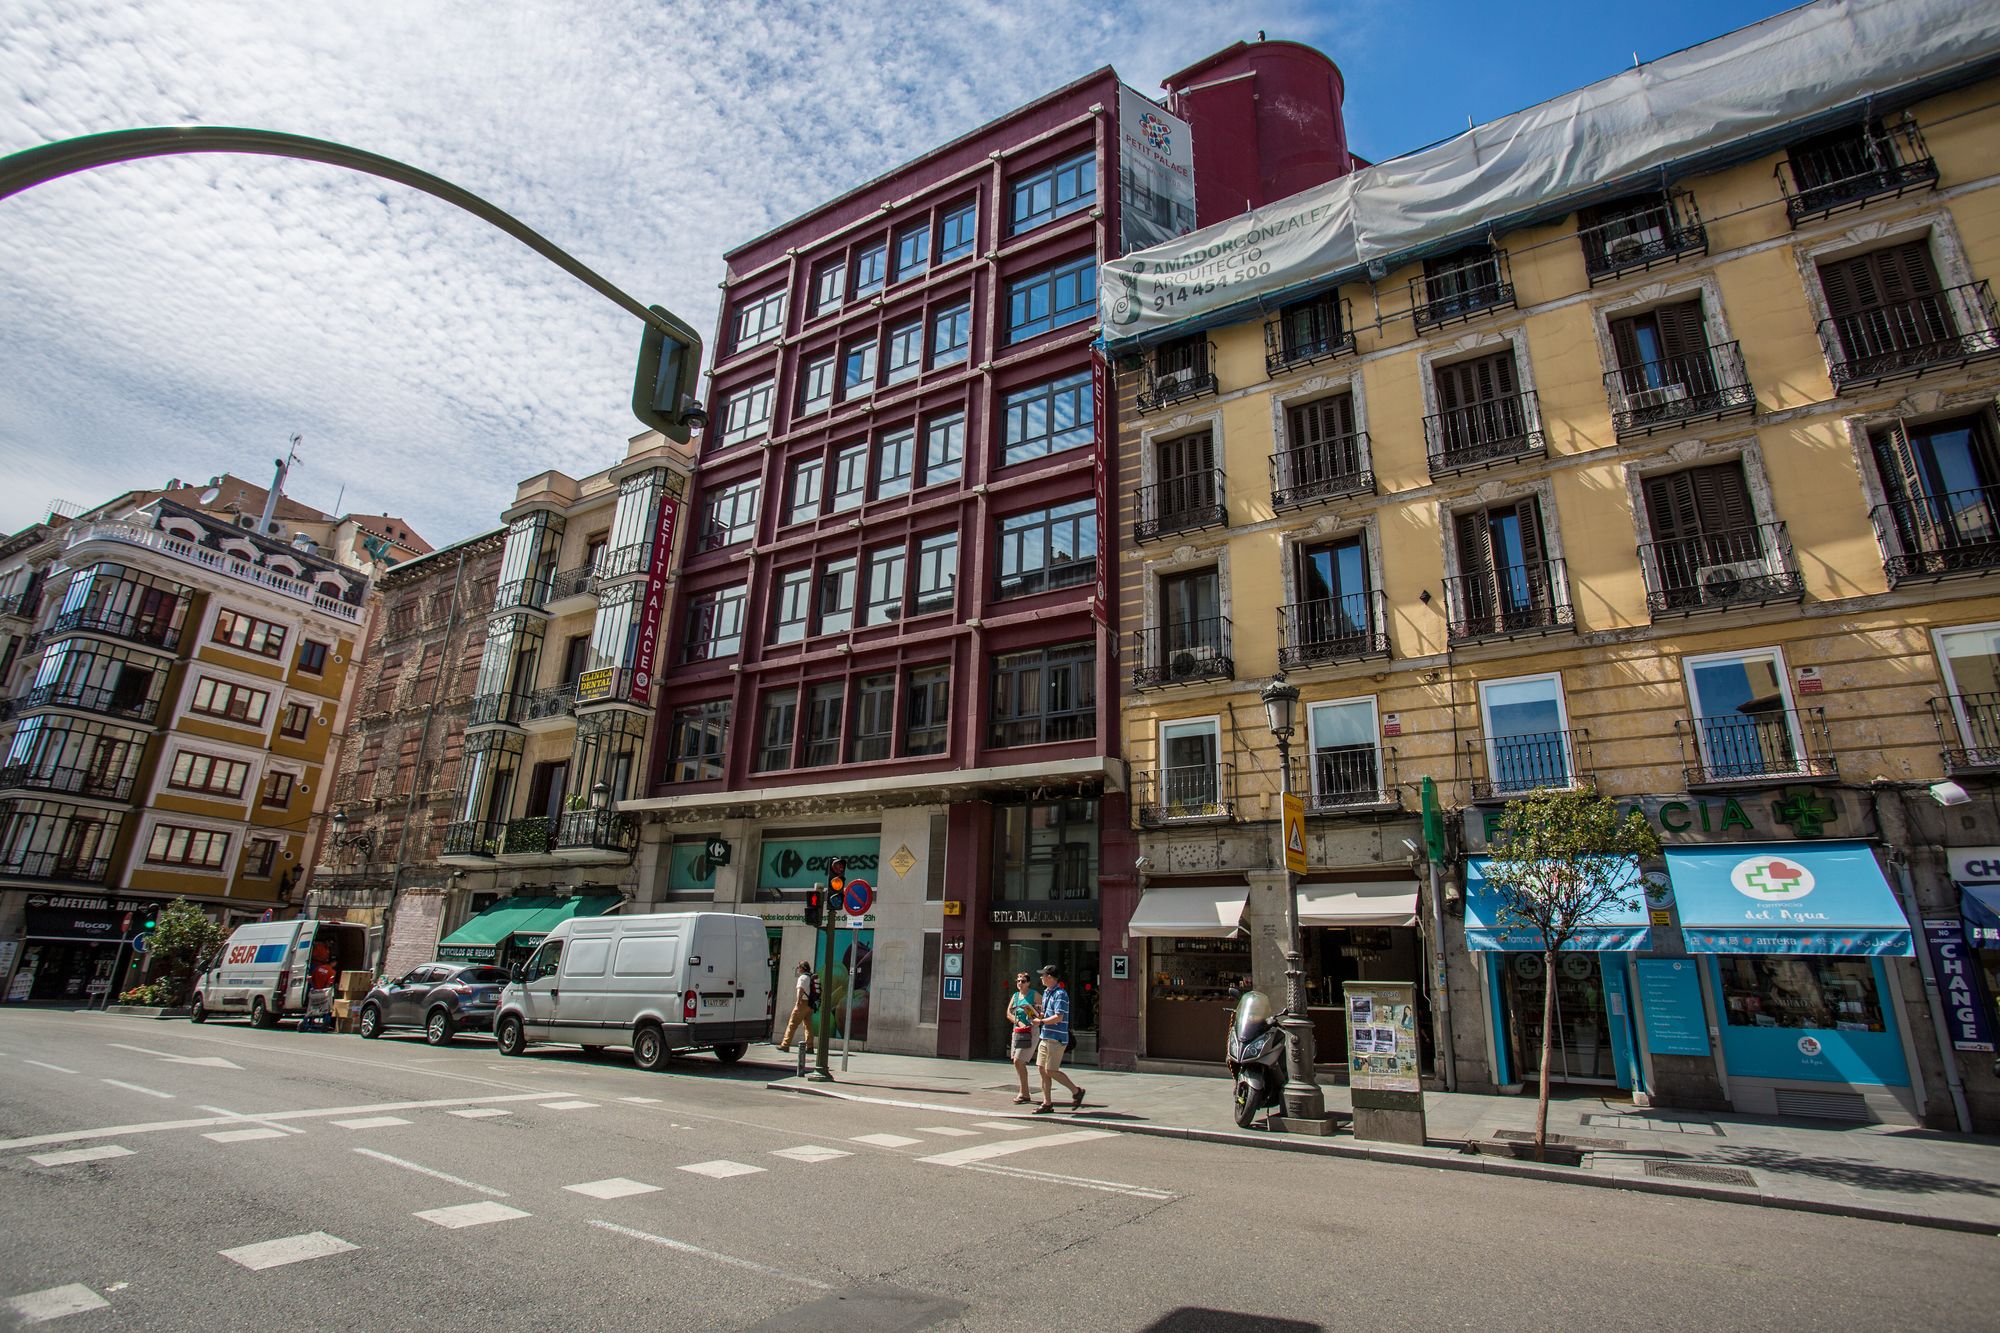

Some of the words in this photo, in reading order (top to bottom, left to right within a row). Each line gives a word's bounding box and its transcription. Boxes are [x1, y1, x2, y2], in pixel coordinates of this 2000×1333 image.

[1126, 134, 1151, 156] PETIT
[1153, 152, 1188, 177] PALACE
[1153, 248, 1262, 294] ARQUITECTO
[1154, 286, 1188, 312] 914
[1192, 275, 1228, 297] 454
[1233, 261, 1271, 284] 500
[1095, 364, 1103, 453] PETIT
[1096, 464, 1104, 576] PALACE
[656, 504, 673, 575] PETIT
[640, 580, 661, 669] PALACE
[580, 678, 611, 690] DENTAL
[581, 669, 613, 682] CLINICA
[49, 897, 108, 910] CAFETERÍA
[116, 901, 139, 912] BAR
[1745, 910, 1773, 920] del
[1780, 910, 1830, 923] Agua
[74, 920, 112, 931] Mocay
[228, 945, 258, 964] SEUR
[439, 947, 465, 957] ARTICULOS
[466, 948, 474, 957] DE
[475, 948, 496, 957] REGALO
[949, 980, 957, 992] H
[1940, 944, 1977, 1039] CHANGE
